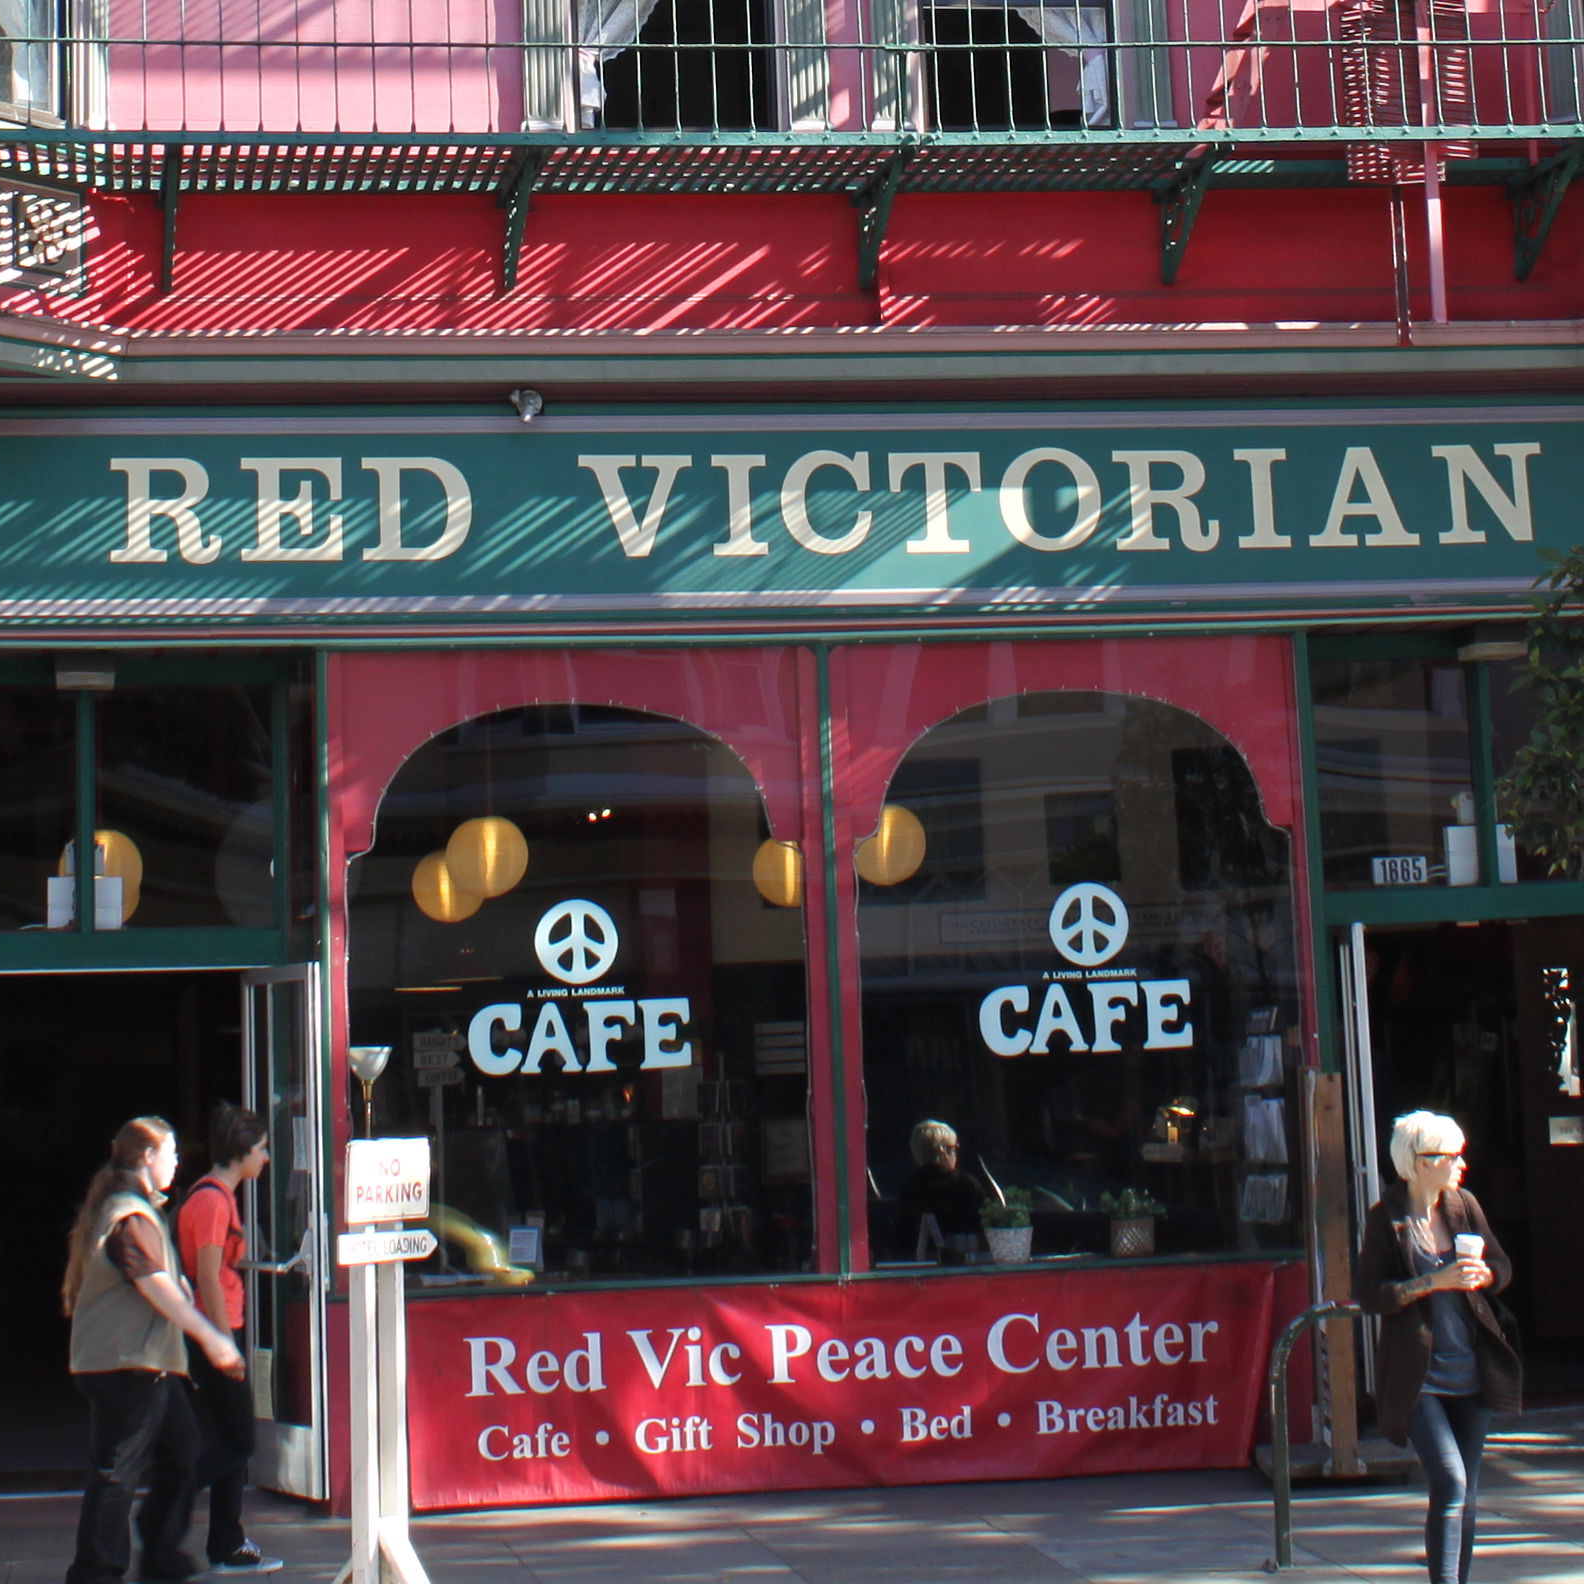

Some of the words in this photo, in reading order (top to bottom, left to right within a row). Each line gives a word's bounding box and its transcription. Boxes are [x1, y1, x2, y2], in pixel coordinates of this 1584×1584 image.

[109, 453, 475, 565] RED
[576, 441, 1543, 561] VICTORIAN
[527, 989, 535, 999] A
[537, 987, 568, 998] LIVING
[571, 985, 626, 997] LANDMARK
[1042, 971, 1049, 980] A
[1052, 970, 1083, 980] LIVING
[1085, 967, 1138, 979] LANDMARK
[467, 997, 693, 1076] CAFE
[979, 979, 1194, 1057] CAFE
[379, 1158, 401, 1176] NO
[356, 1181, 423, 1204] PARKING
[350, 1239, 380, 1257] HOTEL
[383, 1235, 428, 1256] LOADING
[464, 1331, 607, 1398] Red
[627, 1325, 742, 1390] Vic
[765, 1322, 964, 1385] Peace
[986, 1312, 1220, 1375] Center
[476, 1422, 571, 1462] Cafe
[634, 1415, 714, 1455] Gift
[736, 1413, 837, 1456] Shop
[900, 1405, 973, 1444] Bed
[1036, 1392, 1220, 1437] Breakfast
